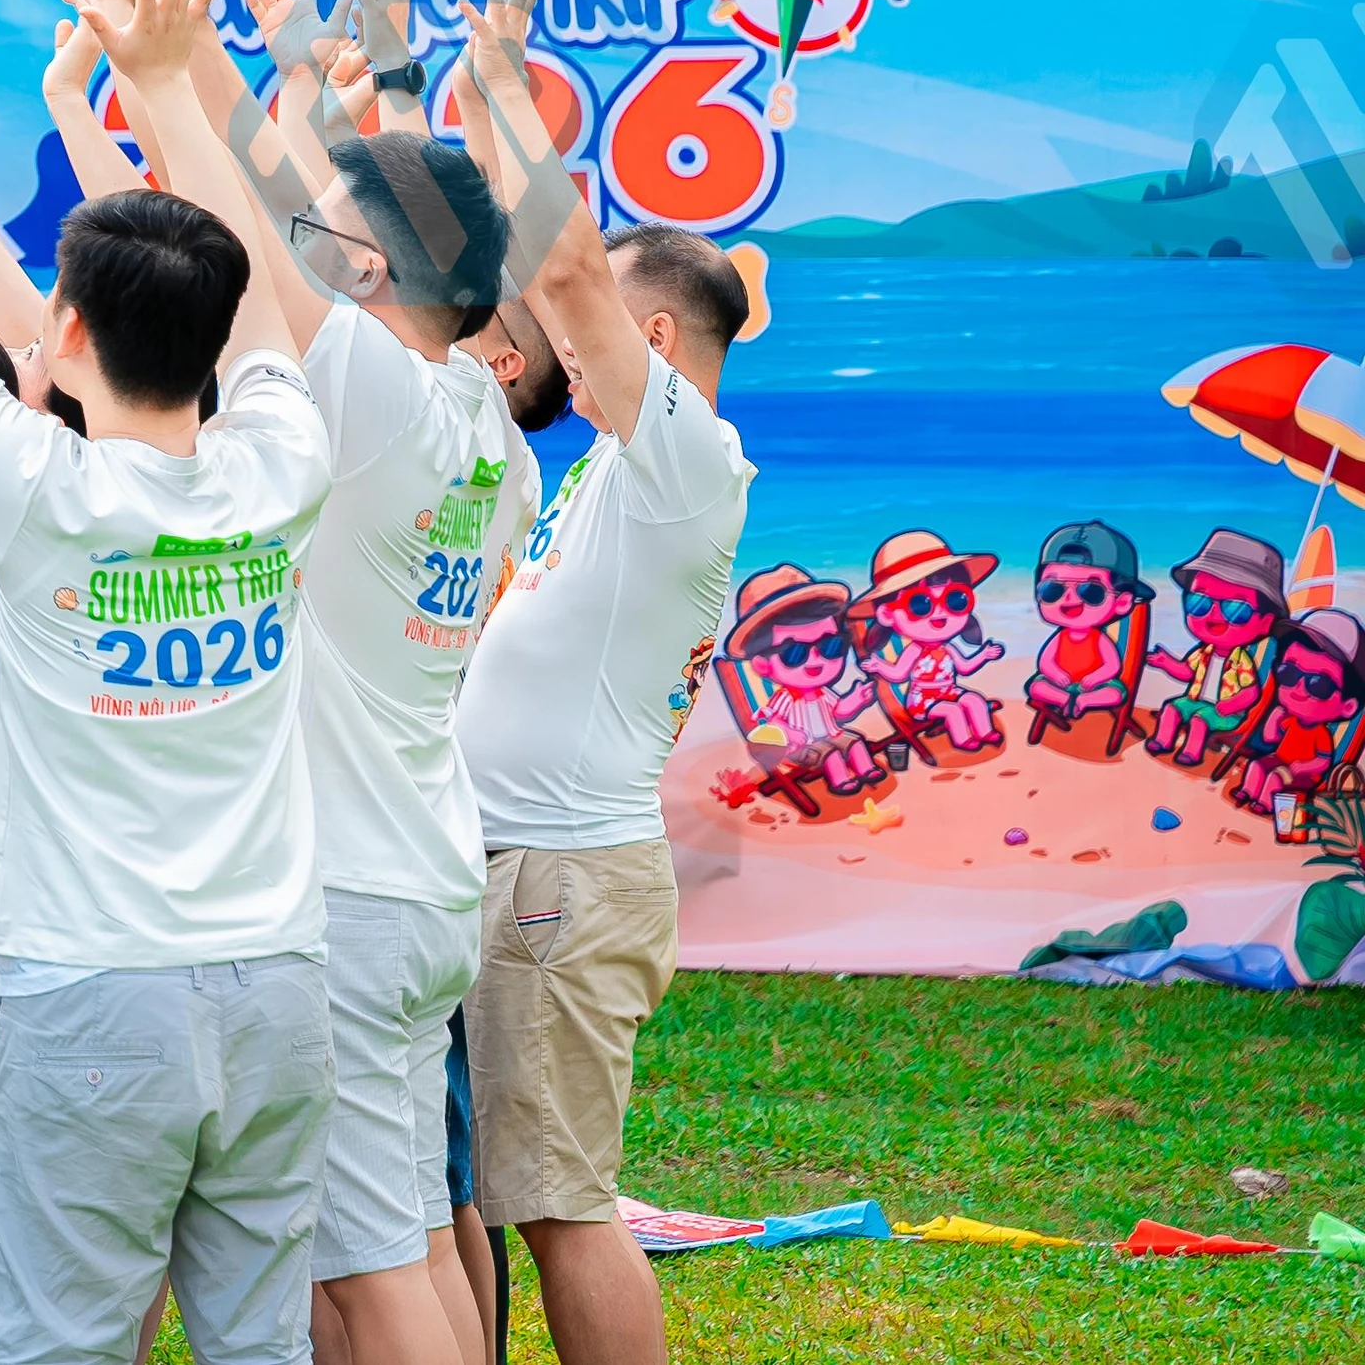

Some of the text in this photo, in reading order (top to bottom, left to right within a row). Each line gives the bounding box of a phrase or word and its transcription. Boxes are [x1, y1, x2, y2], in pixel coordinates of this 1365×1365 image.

[769, 84, 792, 126] S
[88, 549, 292, 625] SUMMER TRIP
[417, 551, 483, 618] 202
[96, 602, 284, 687] 2026
